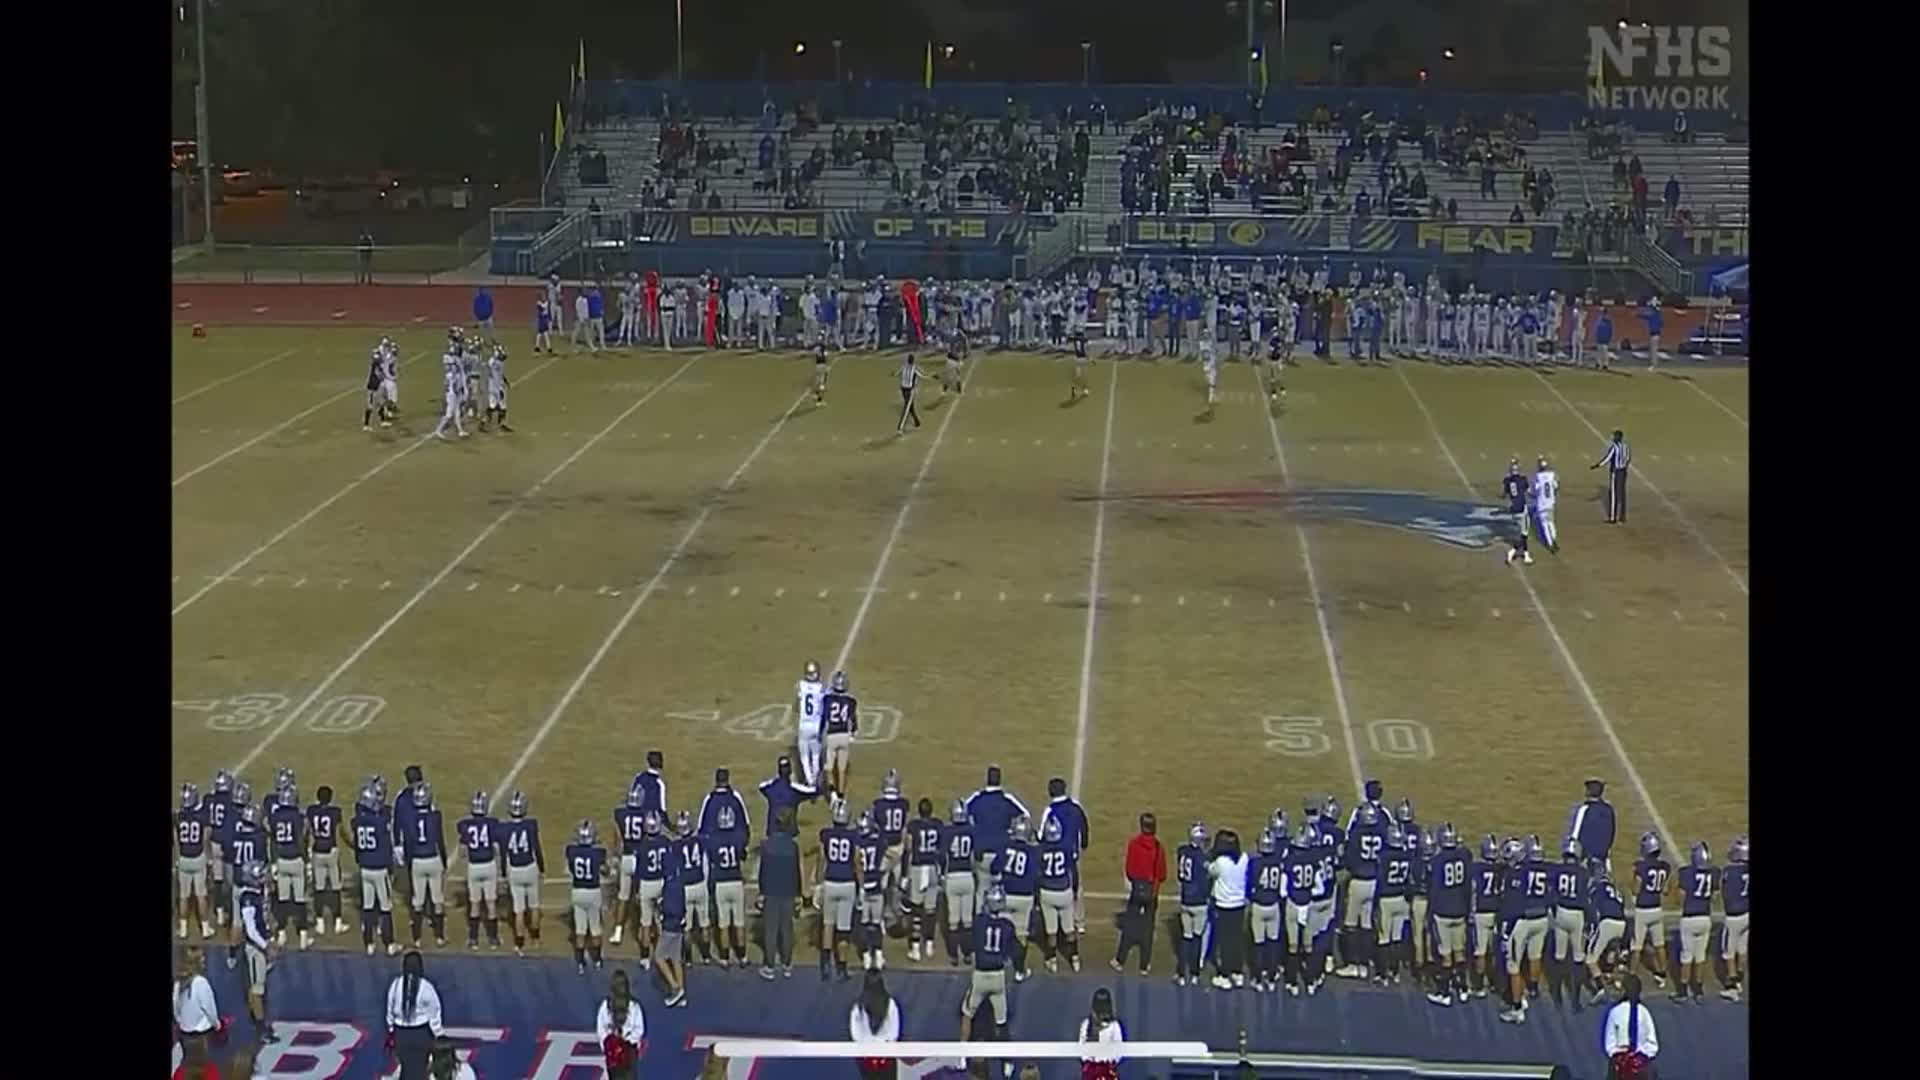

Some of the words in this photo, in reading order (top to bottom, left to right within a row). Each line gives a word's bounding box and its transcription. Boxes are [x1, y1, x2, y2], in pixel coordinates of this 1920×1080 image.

[690, 216, 817, 236] BEWARE
[874, 218, 912, 237] OF
[927, 219, 986, 237] THE
[1417, 224, 1533, 253] FEAR
[805, 694, 813, 716] 6
[831, 702, 848, 722] 24
[1263, 715, 1436, 760] 50
[209, 803, 225, 826] 16
[885, 808, 903, 831] 18
[179, 821, 200, 844] 28
[276, 822, 293, 842] 21
[313, 815, 331, 838] 13
[357, 826, 377, 850] 85
[417, 821, 426, 842] 1
[467, 825, 489, 848] 34
[624, 816, 642, 840] 15
[233, 841, 254, 864] 70
[508, 832, 528, 854] 44
[828, 838, 850, 861] 68
[920, 829, 938, 853] 12
[950, 836, 971, 858] 40
[1360, 835, 1382, 860] 52
[682, 842, 701, 869] 14
[718, 845, 737, 868] 31
[1005, 850, 1026, 875] 78
[1043, 852, 1065, 875] 72
[574, 857, 593, 879] 61
[1259, 866, 1280, 889] 48
[1292, 865, 1313, 888] 38
[1388, 861, 1409, 883] 23
[1444, 861, 1463, 886] 88
[1558, 873, 1577, 898] 81
[1646, 869, 1666, 892] 30
[1694, 873, 1712, 898] 71
[984, 927, 1000, 952] 11
